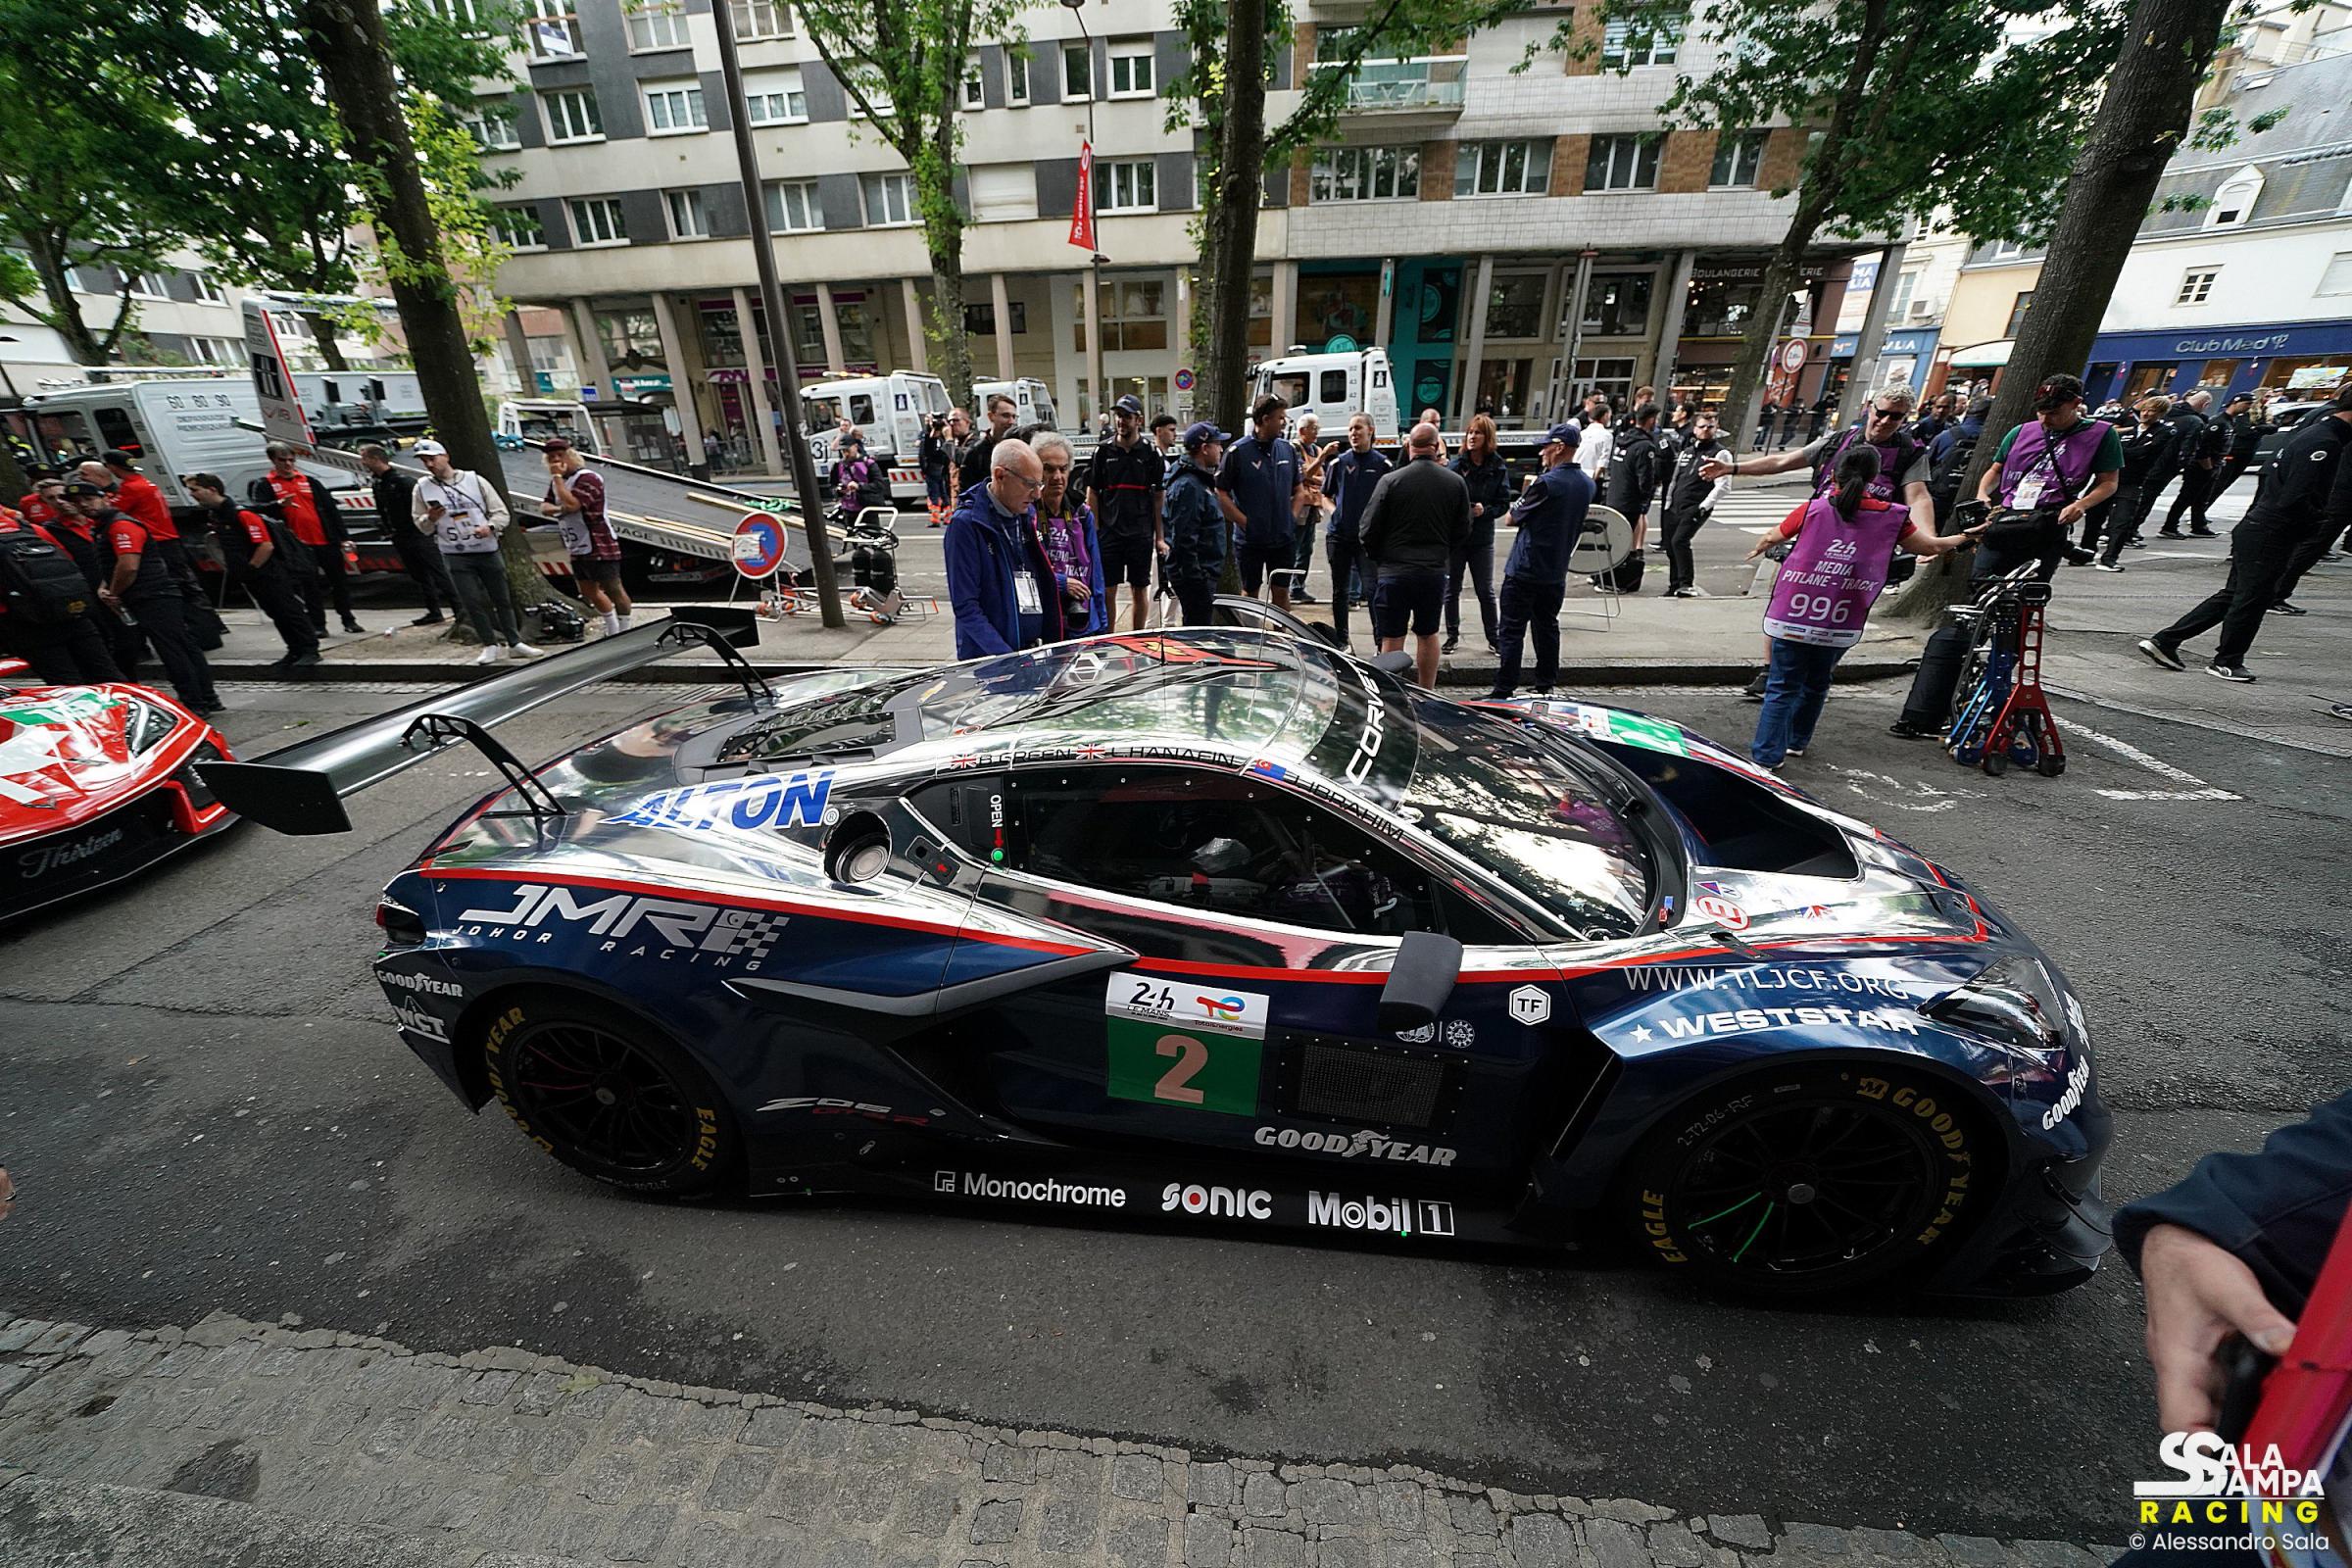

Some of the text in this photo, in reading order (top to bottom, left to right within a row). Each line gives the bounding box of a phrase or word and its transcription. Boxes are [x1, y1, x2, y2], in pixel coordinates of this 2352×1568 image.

[2176, 336, 2271, 354] Club Med
[1782, 569, 1832, 587] PITLANE
[1840, 577, 1879, 592] TRACK
[1814, 561, 1854, 577] MEDIA
[1788, 593, 1852, 624] 996
[597, 770, 836, 830] ALTON
[990, 794, 1004, 828] OPEN
[457, 884, 720, 949] JMR
[452, 924, 554, 945] JOHOR
[600, 941, 764, 971] RACING
[376, 966, 463, 998] GOODYEAR
[1624, 966, 1911, 1001] WWW.TLJCF.ORG
[1516, 998, 1543, 1013] TF
[1658, 1006, 1920, 1040] WESTSTAR
[1154, 1034, 1209, 1104] 2
[691, 1106, 718, 1171] EAGLE
[1254, 1126, 1457, 1166] GOODYEAR
[964, 1173, 1126, 1207] Monochrome
[1308, 1190, 1411, 1233] Mobil
[1642, 1189, 1688, 1262] EAGLE
